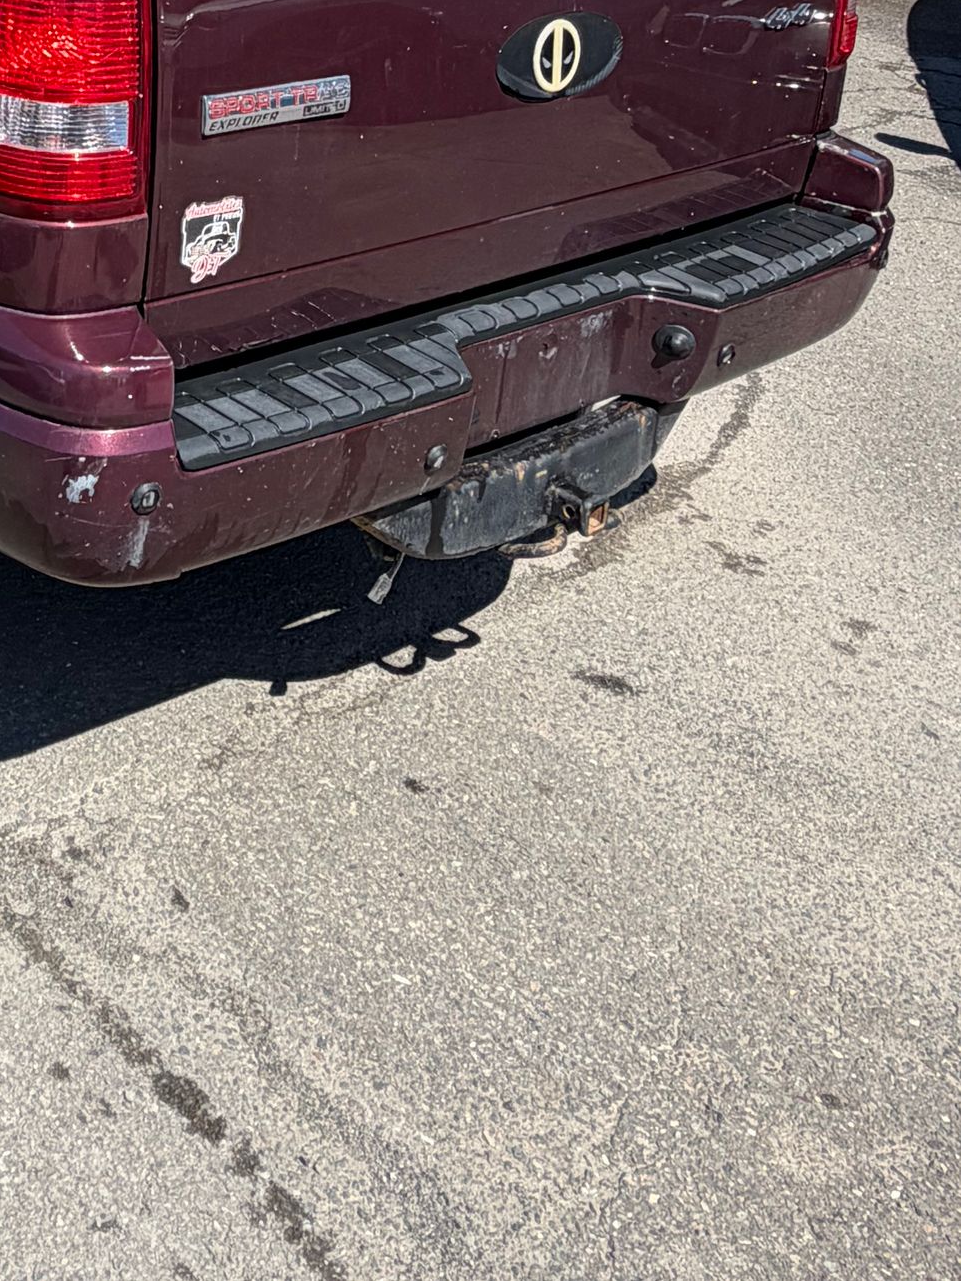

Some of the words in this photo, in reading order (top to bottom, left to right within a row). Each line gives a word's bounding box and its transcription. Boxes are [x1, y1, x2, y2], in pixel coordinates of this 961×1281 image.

[208, 91, 283, 119] SPORT
[290, 79, 350, 106] TRAC
[208, 111, 279, 132] EXPLORER
